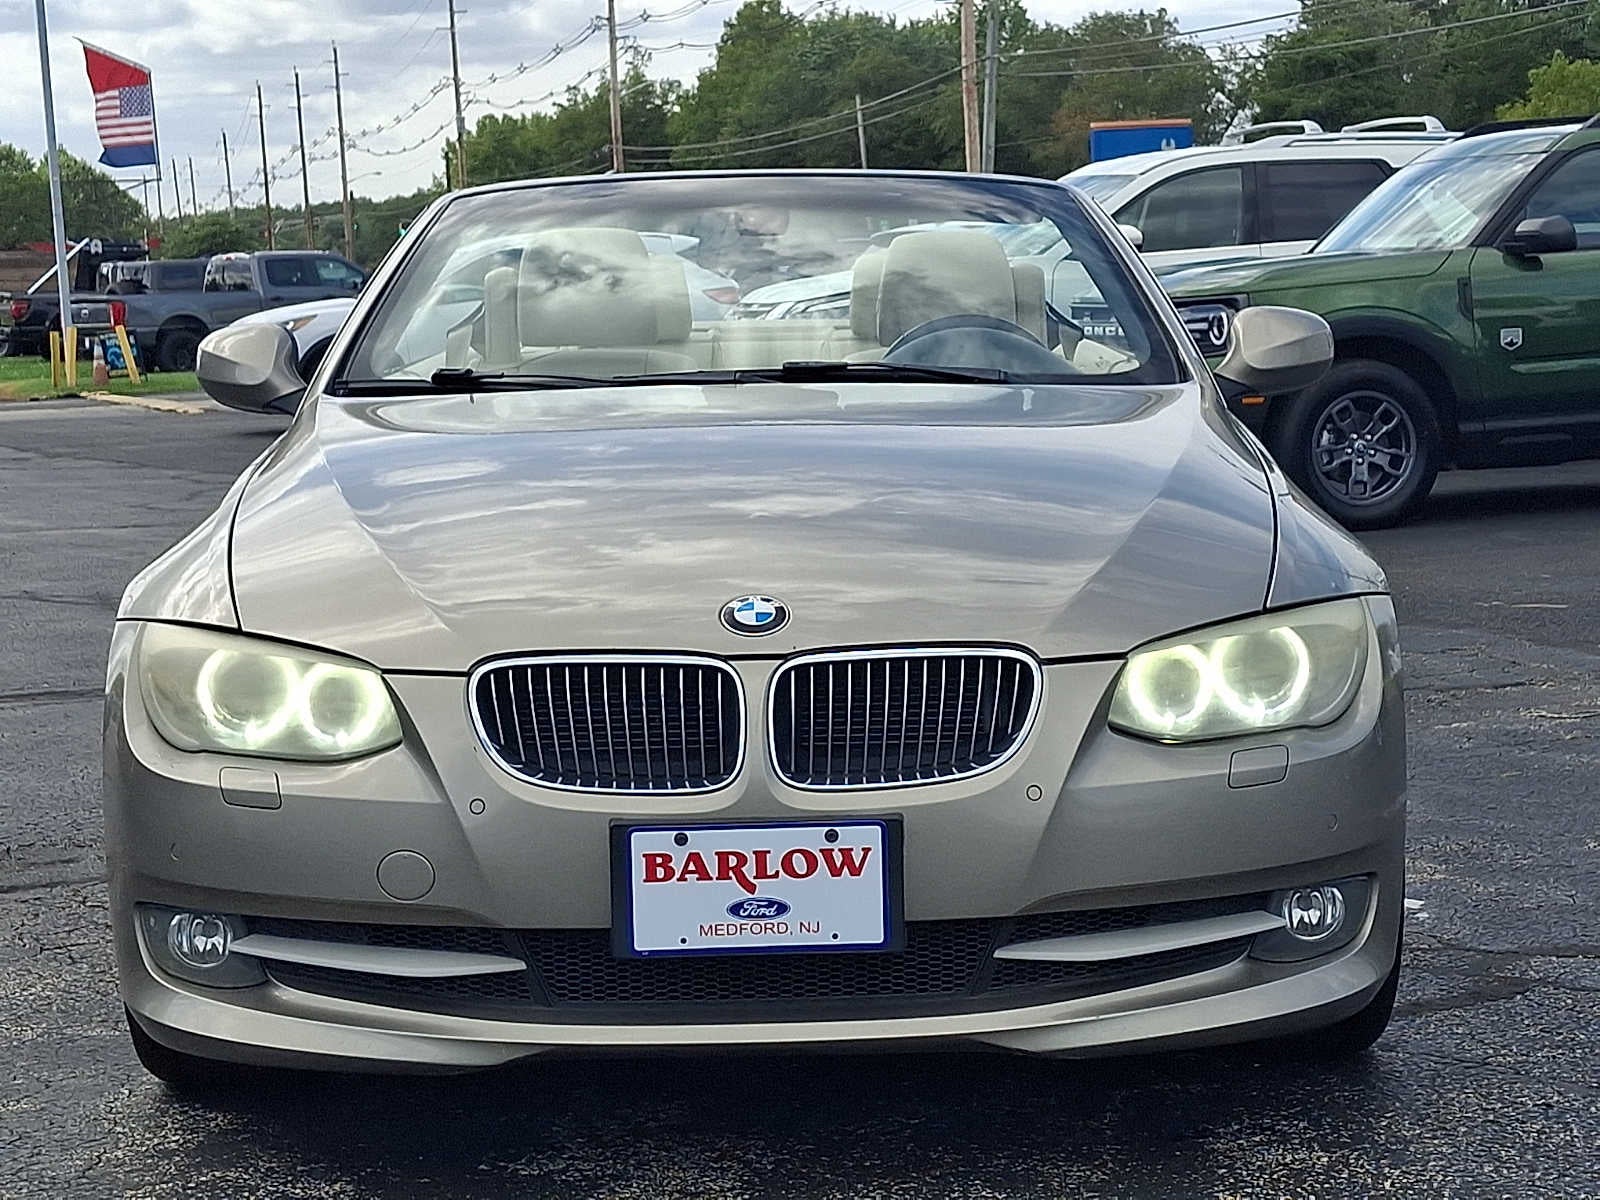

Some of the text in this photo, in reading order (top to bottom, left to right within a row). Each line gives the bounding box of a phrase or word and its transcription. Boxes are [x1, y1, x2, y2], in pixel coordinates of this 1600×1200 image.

[642, 847, 872, 895] BARLOW
[739, 901, 778, 917] Ford
[699, 921, 820, 936] MEDFORD, NJ
